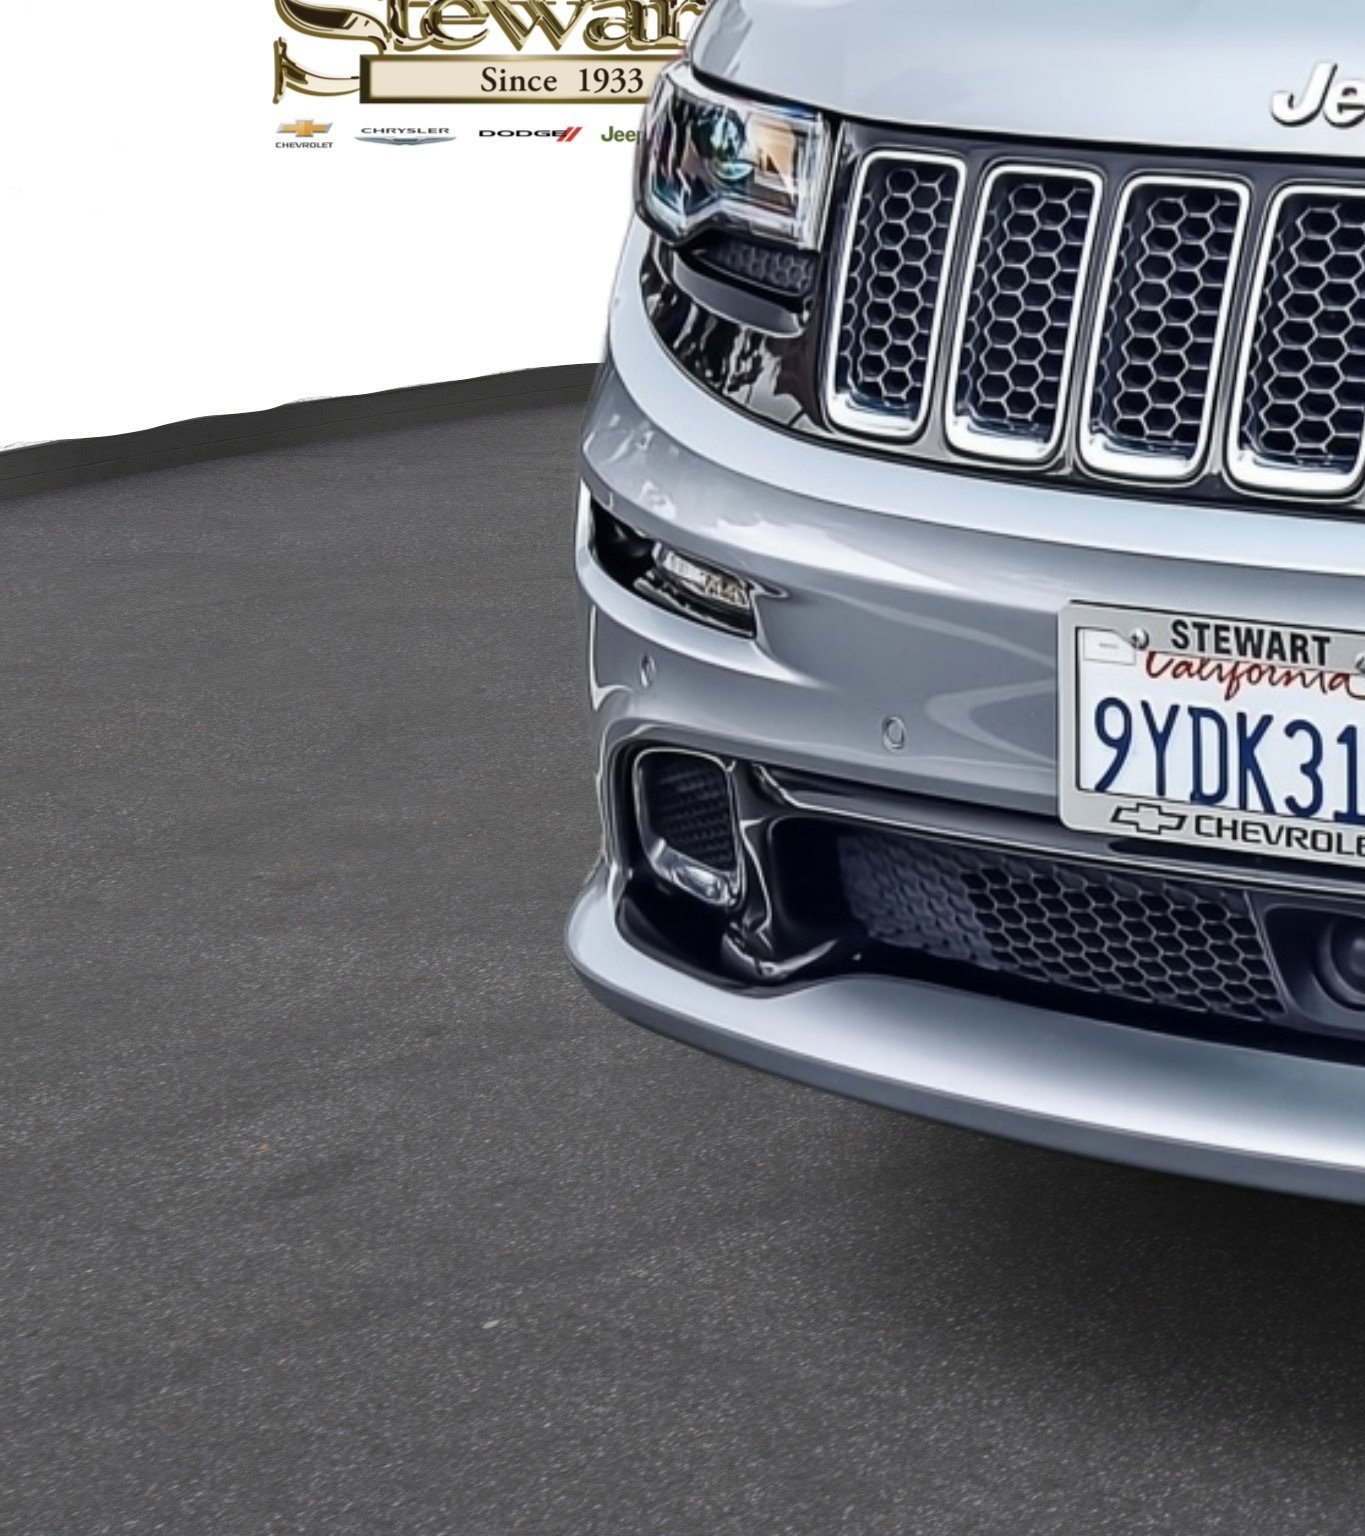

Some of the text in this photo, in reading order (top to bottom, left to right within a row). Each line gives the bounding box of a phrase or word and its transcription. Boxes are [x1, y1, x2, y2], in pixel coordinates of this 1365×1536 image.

[481, 66, 645, 94] Since 1933
[1170, 619, 1331, 666] STEWART
